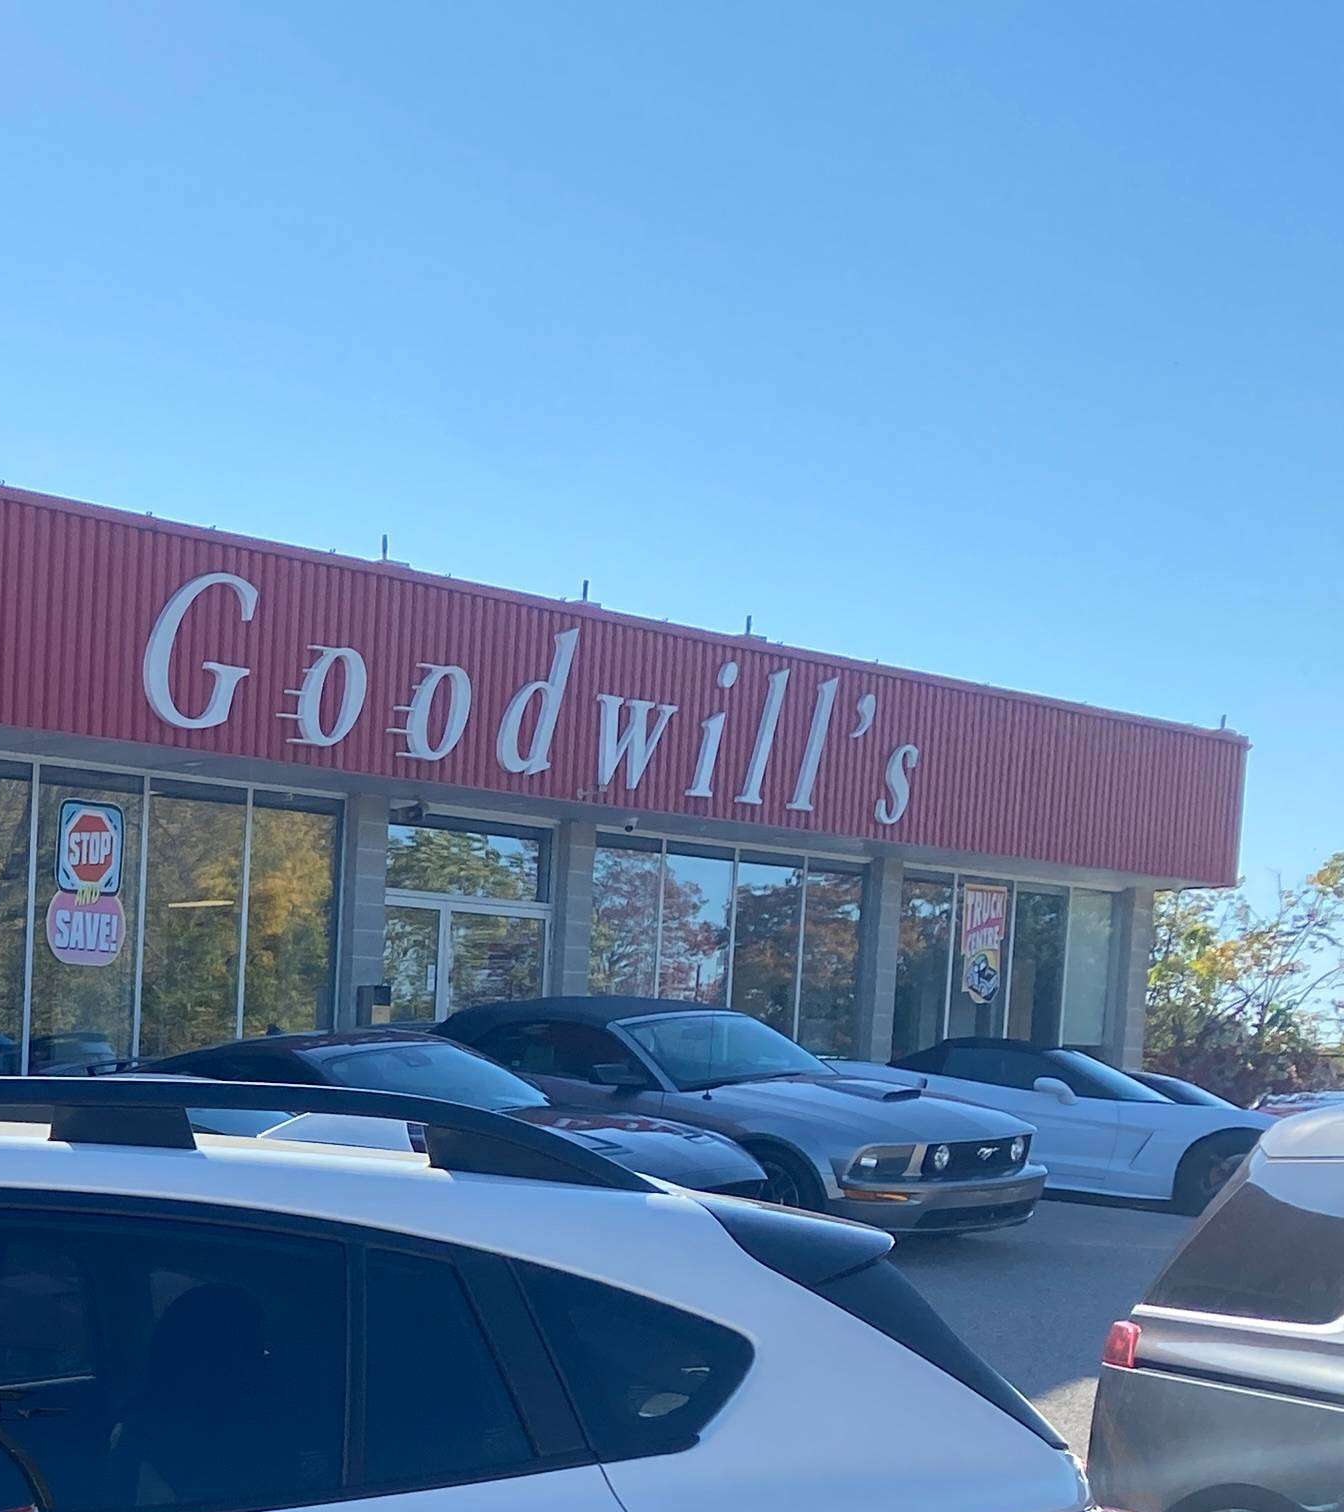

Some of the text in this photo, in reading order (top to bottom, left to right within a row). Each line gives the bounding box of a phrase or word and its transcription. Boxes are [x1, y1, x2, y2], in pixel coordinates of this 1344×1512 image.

[143, 572, 919, 825] Goodwill's
[68, 831, 112, 866] STOP
[74, 887, 100, 906] AND
[967, 890, 1004, 932] TRUCK
[54, 909, 119, 953] SAVE!
